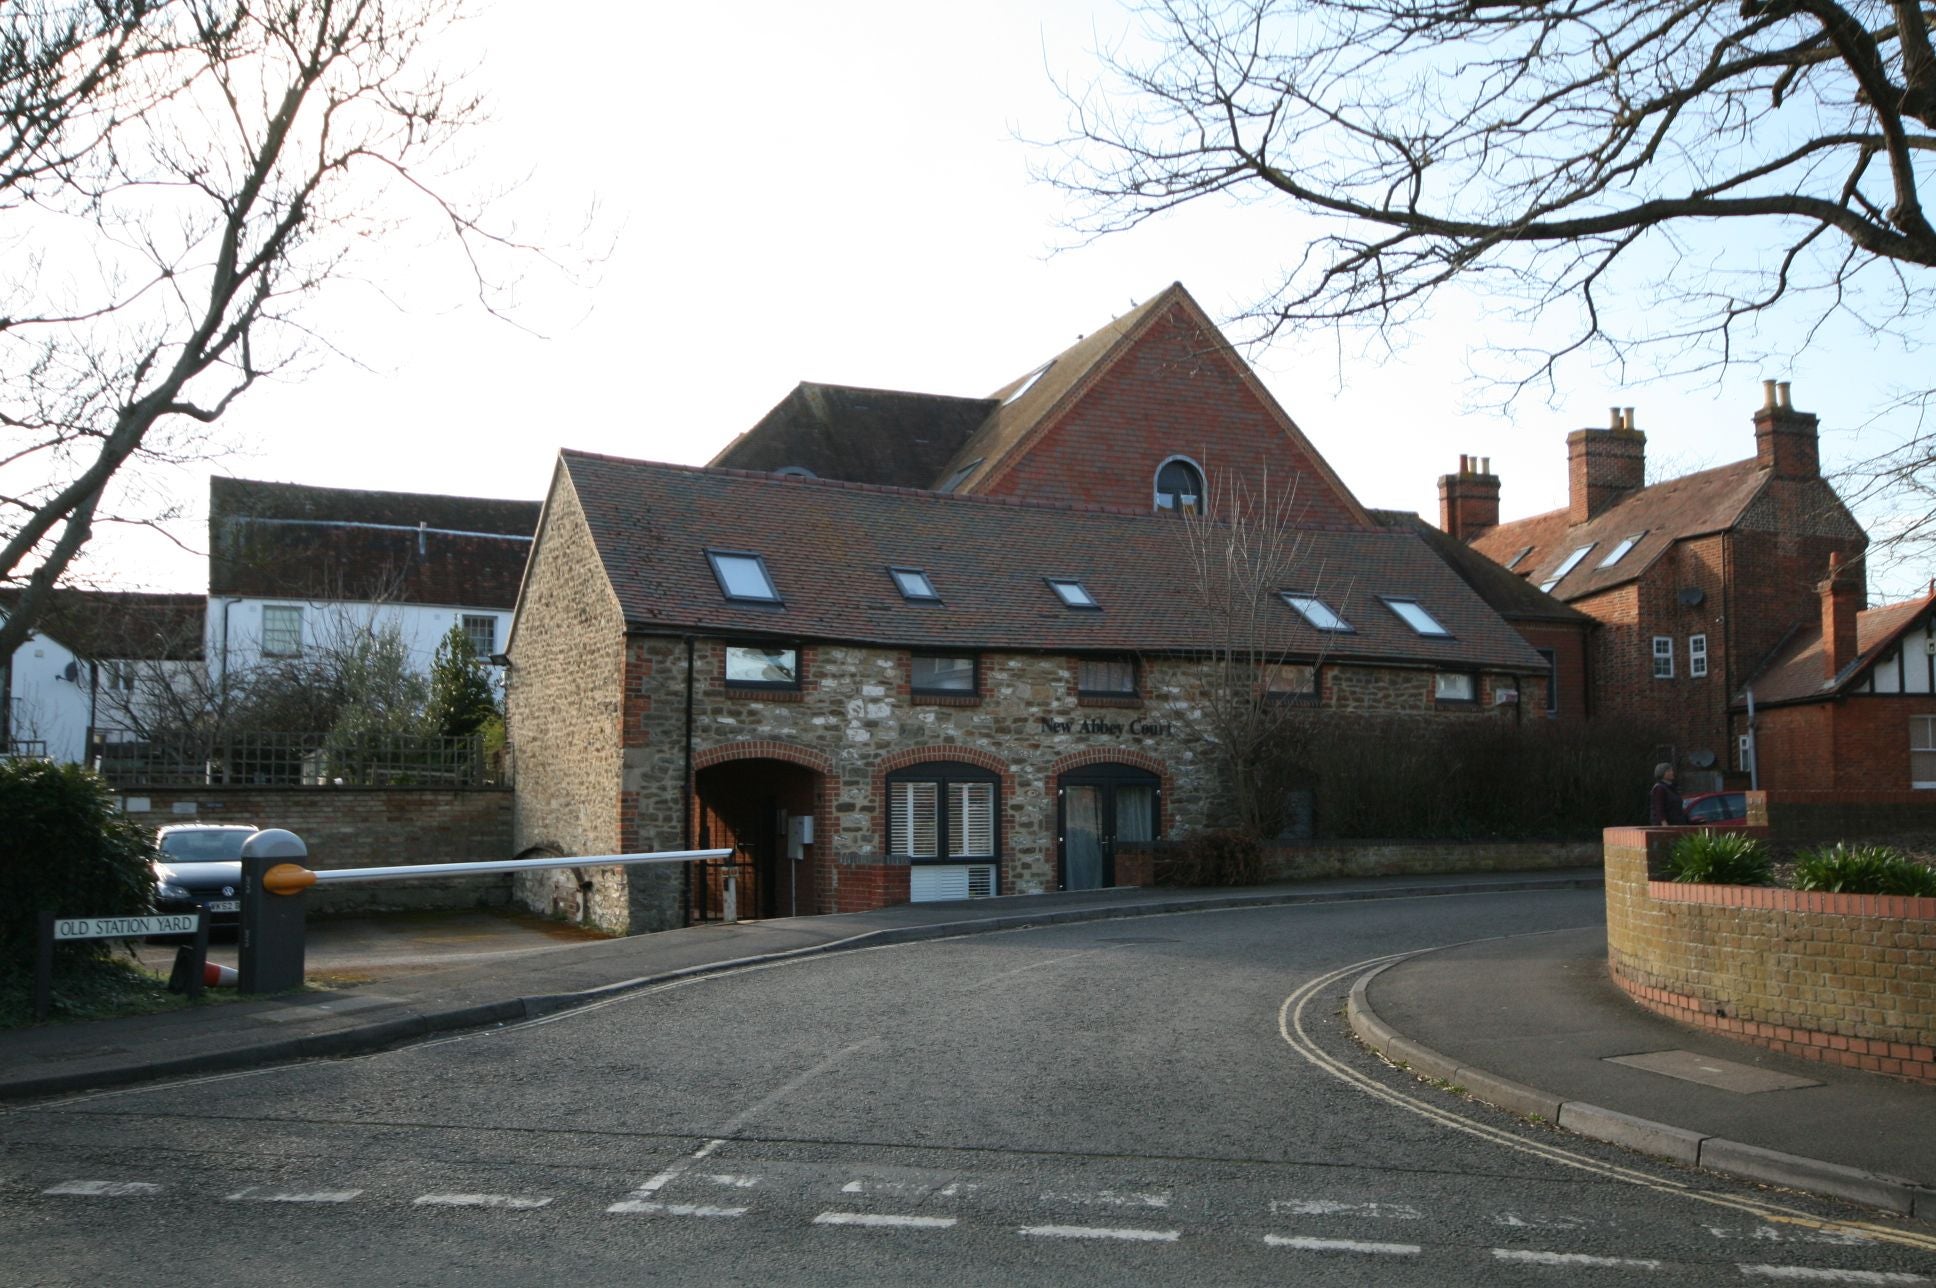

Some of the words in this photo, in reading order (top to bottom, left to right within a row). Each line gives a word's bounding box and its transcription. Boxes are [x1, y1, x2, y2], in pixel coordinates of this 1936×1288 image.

[1041, 718, 1073, 734] New
[1080, 719, 1124, 739] Abbey
[1130, 719, 1172, 736] Court
[60, 921, 89, 936] OLD
[95, 918, 150, 935] STATION
[157, 916, 192, 932] YARD
